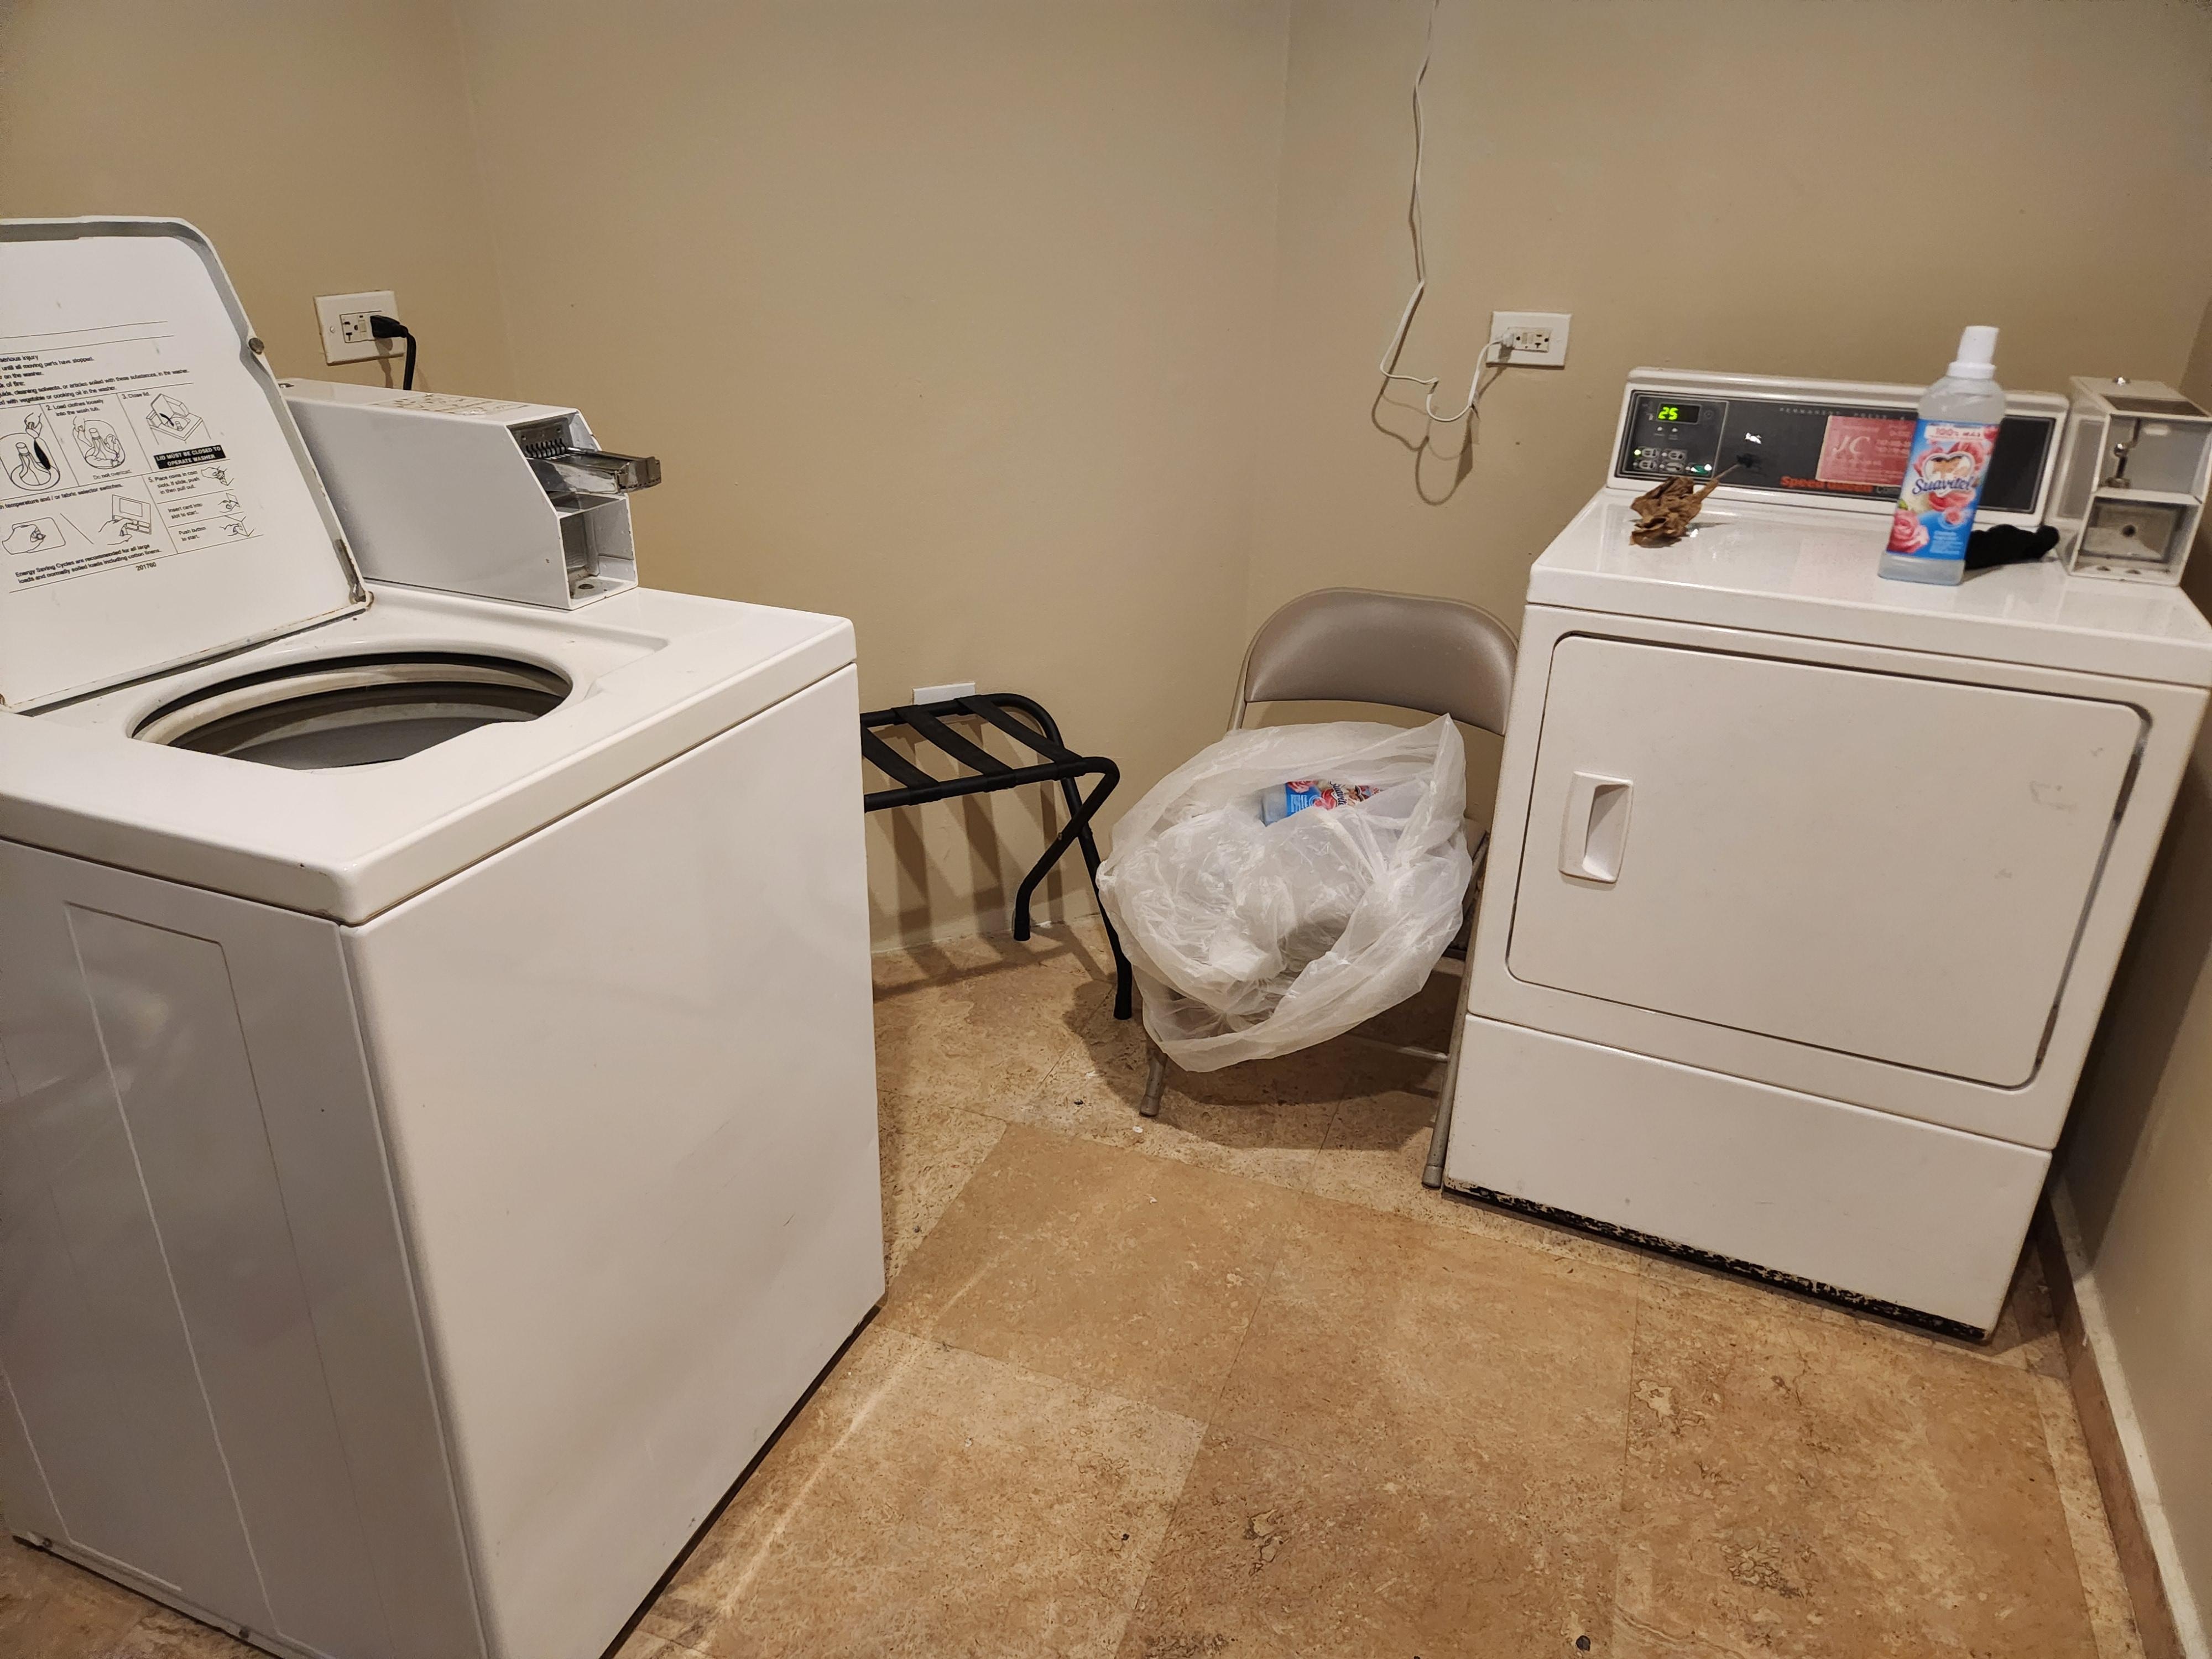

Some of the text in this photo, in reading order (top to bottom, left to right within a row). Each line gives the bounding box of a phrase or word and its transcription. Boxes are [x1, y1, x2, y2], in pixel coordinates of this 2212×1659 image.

[14, 387, 38, 395] cleaning
[19, 395, 45, 404] vegetable
[53, 391, 75, 399] cooking
[1657, 406, 1679, 420] 25
[191, 447, 213, 456] CLOSED
[167, 453, 216, 467] OPERATE WASHER
[1912, 476, 1974, 495] Suavitel
[5, 498, 39, 509] temperature
[15, 569, 36, 578] Energy
[36, 565, 56, 573] Saving
[56, 560, 75, 569] Cycles
[85, 550, 122, 562] recommended
[46, 568, 71, 578] normally
[104, 556, 128, 565] including
[128, 551, 145, 560] cotton
